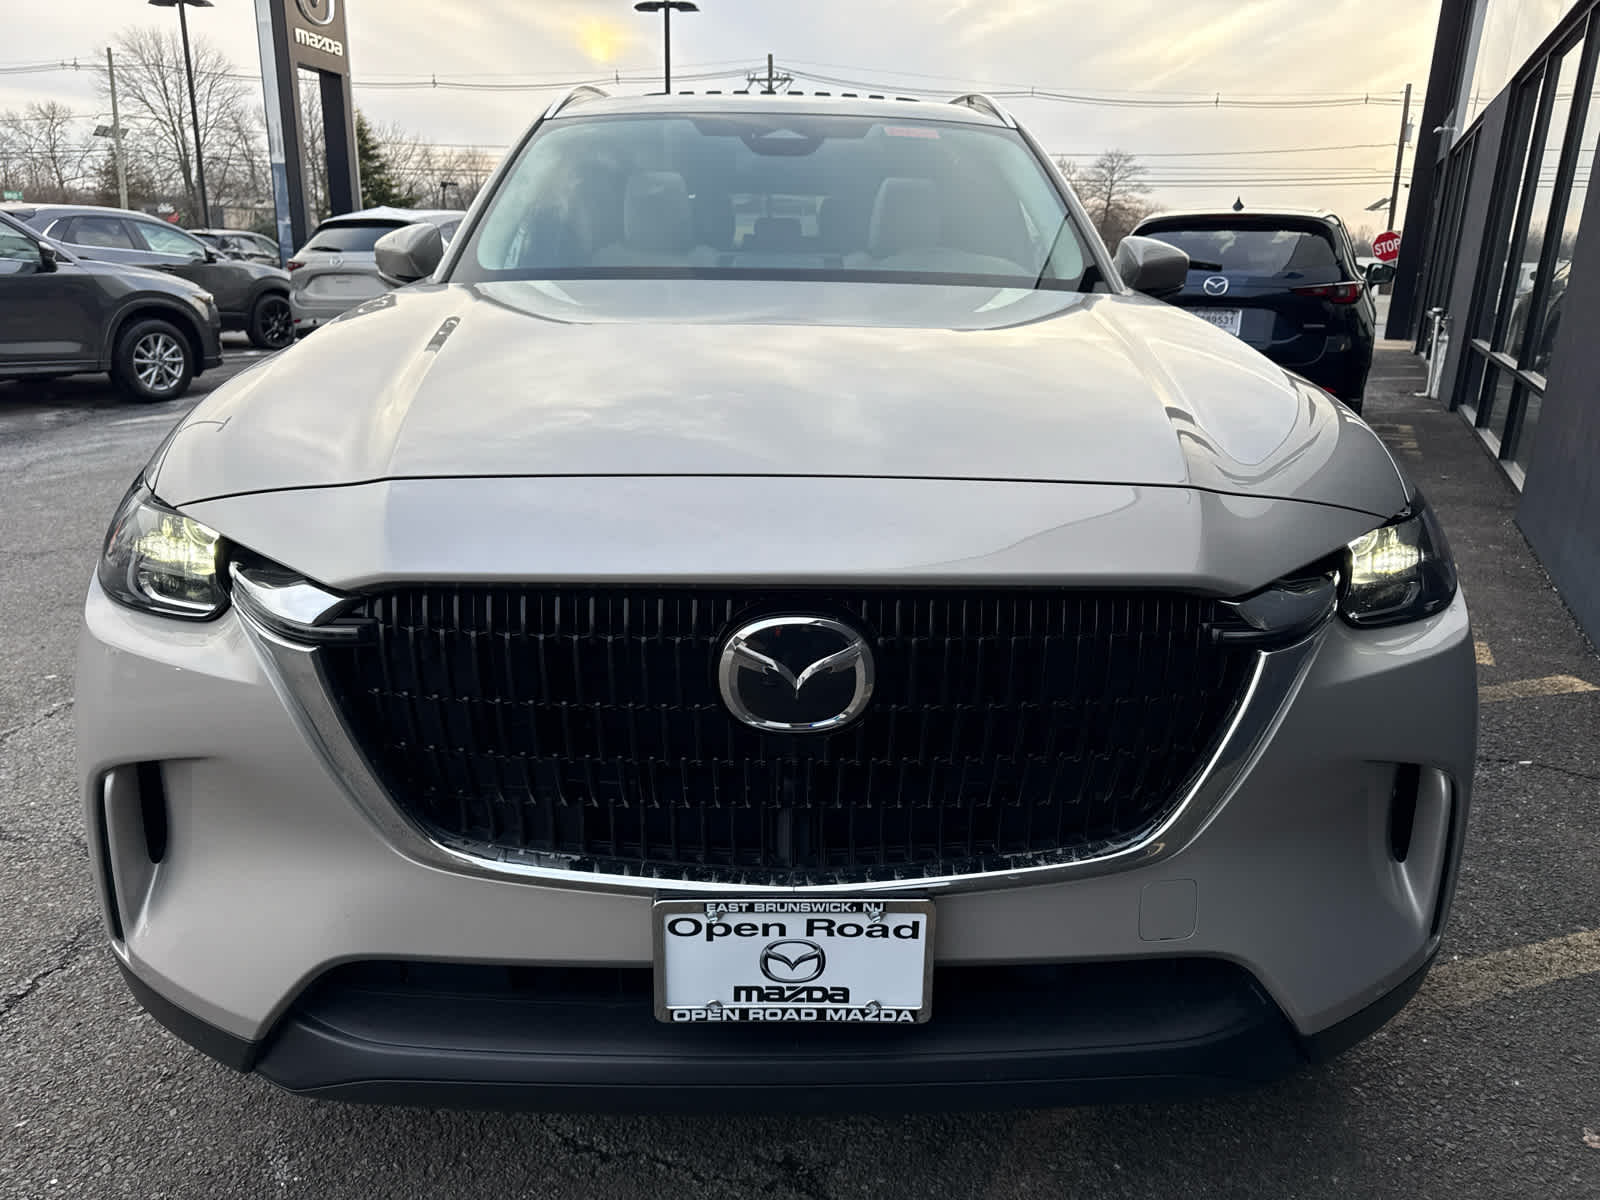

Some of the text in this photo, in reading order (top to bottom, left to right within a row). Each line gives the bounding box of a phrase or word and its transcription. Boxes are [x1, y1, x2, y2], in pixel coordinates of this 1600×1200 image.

[294, 27, 344, 56] mazda
[1374, 237, 1400, 256] STOP
[706, 902, 884, 914] EAST BRUNSWICK, NJ
[667, 917, 920, 941] Open Road
[733, 985, 850, 1004] mazda
[672, 1008, 914, 1023] OPEN ROAD MAZDA
